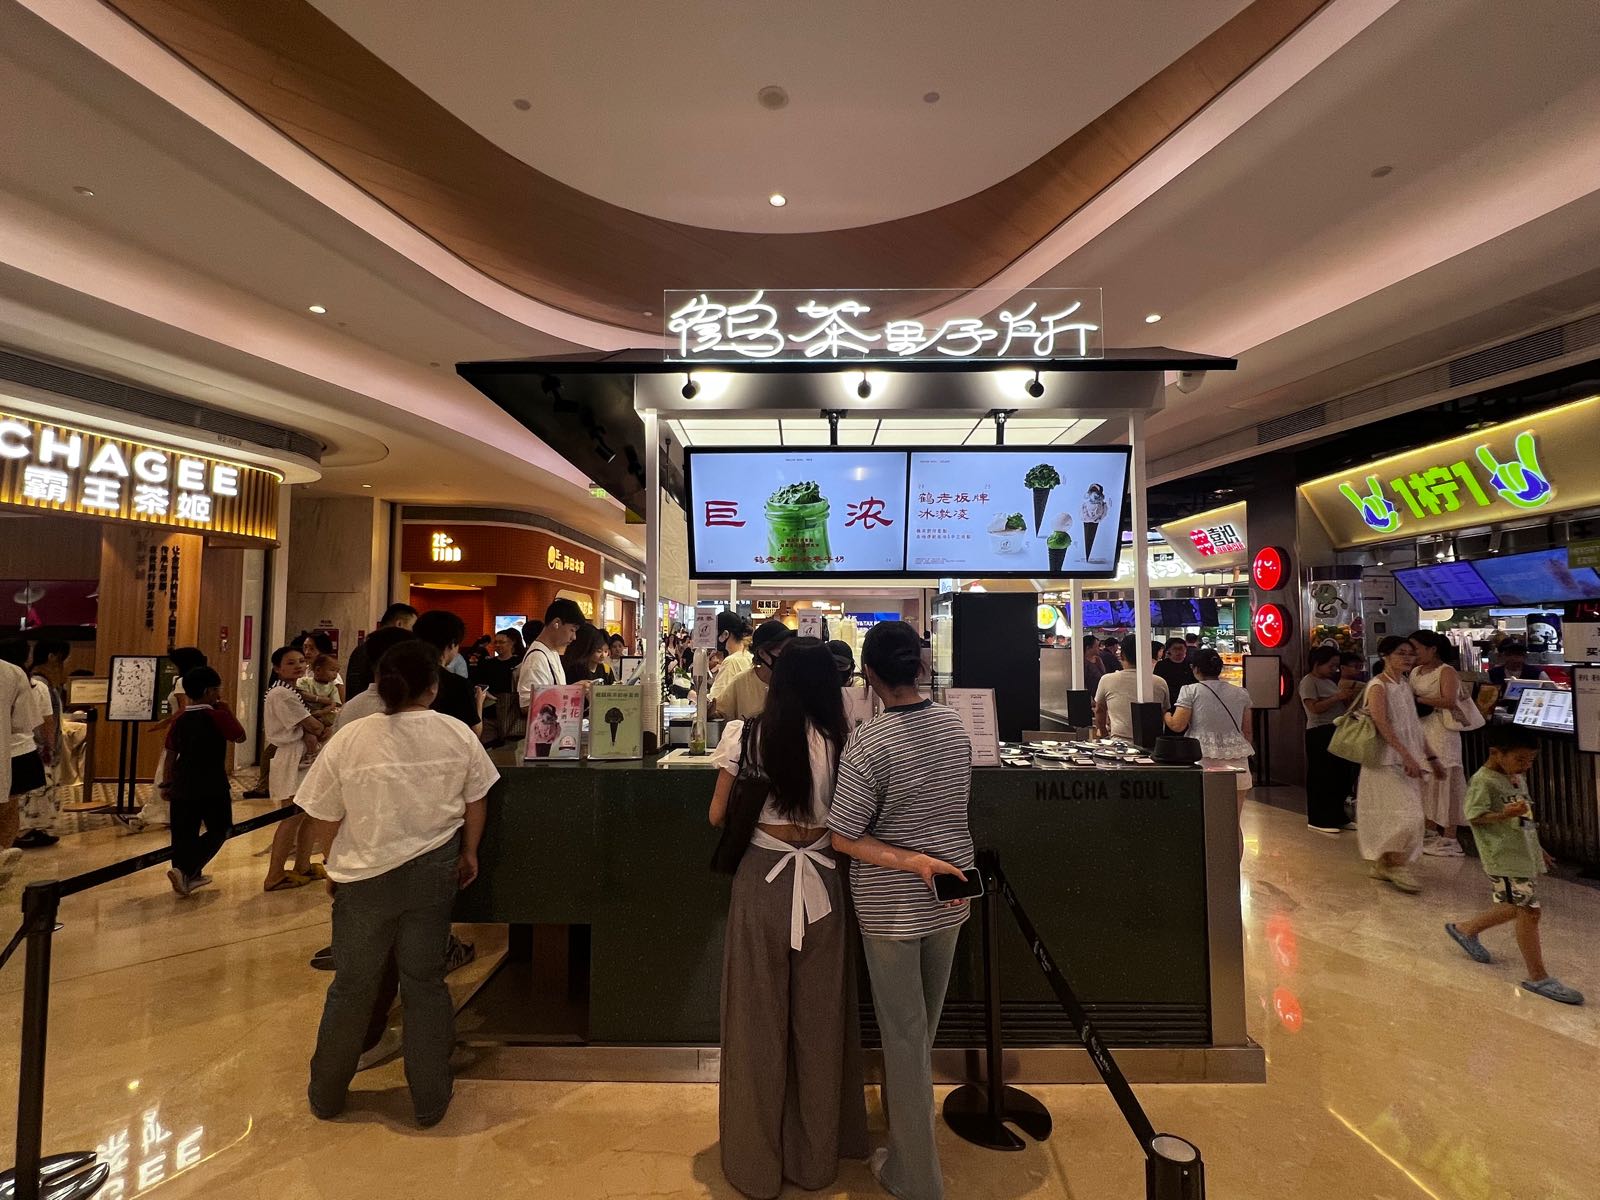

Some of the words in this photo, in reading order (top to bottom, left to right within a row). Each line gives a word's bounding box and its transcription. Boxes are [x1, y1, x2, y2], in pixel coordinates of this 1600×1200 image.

[0, 420, 238, 496] CHAGEE
[23, 466, 212, 522] 霸王茶姬
[704, 500, 746, 528] 巨
[845, 498, 894, 530] 浓
[1035, 780, 1108, 800] HALCHA
[1120, 780, 1170, 800] SOUL
